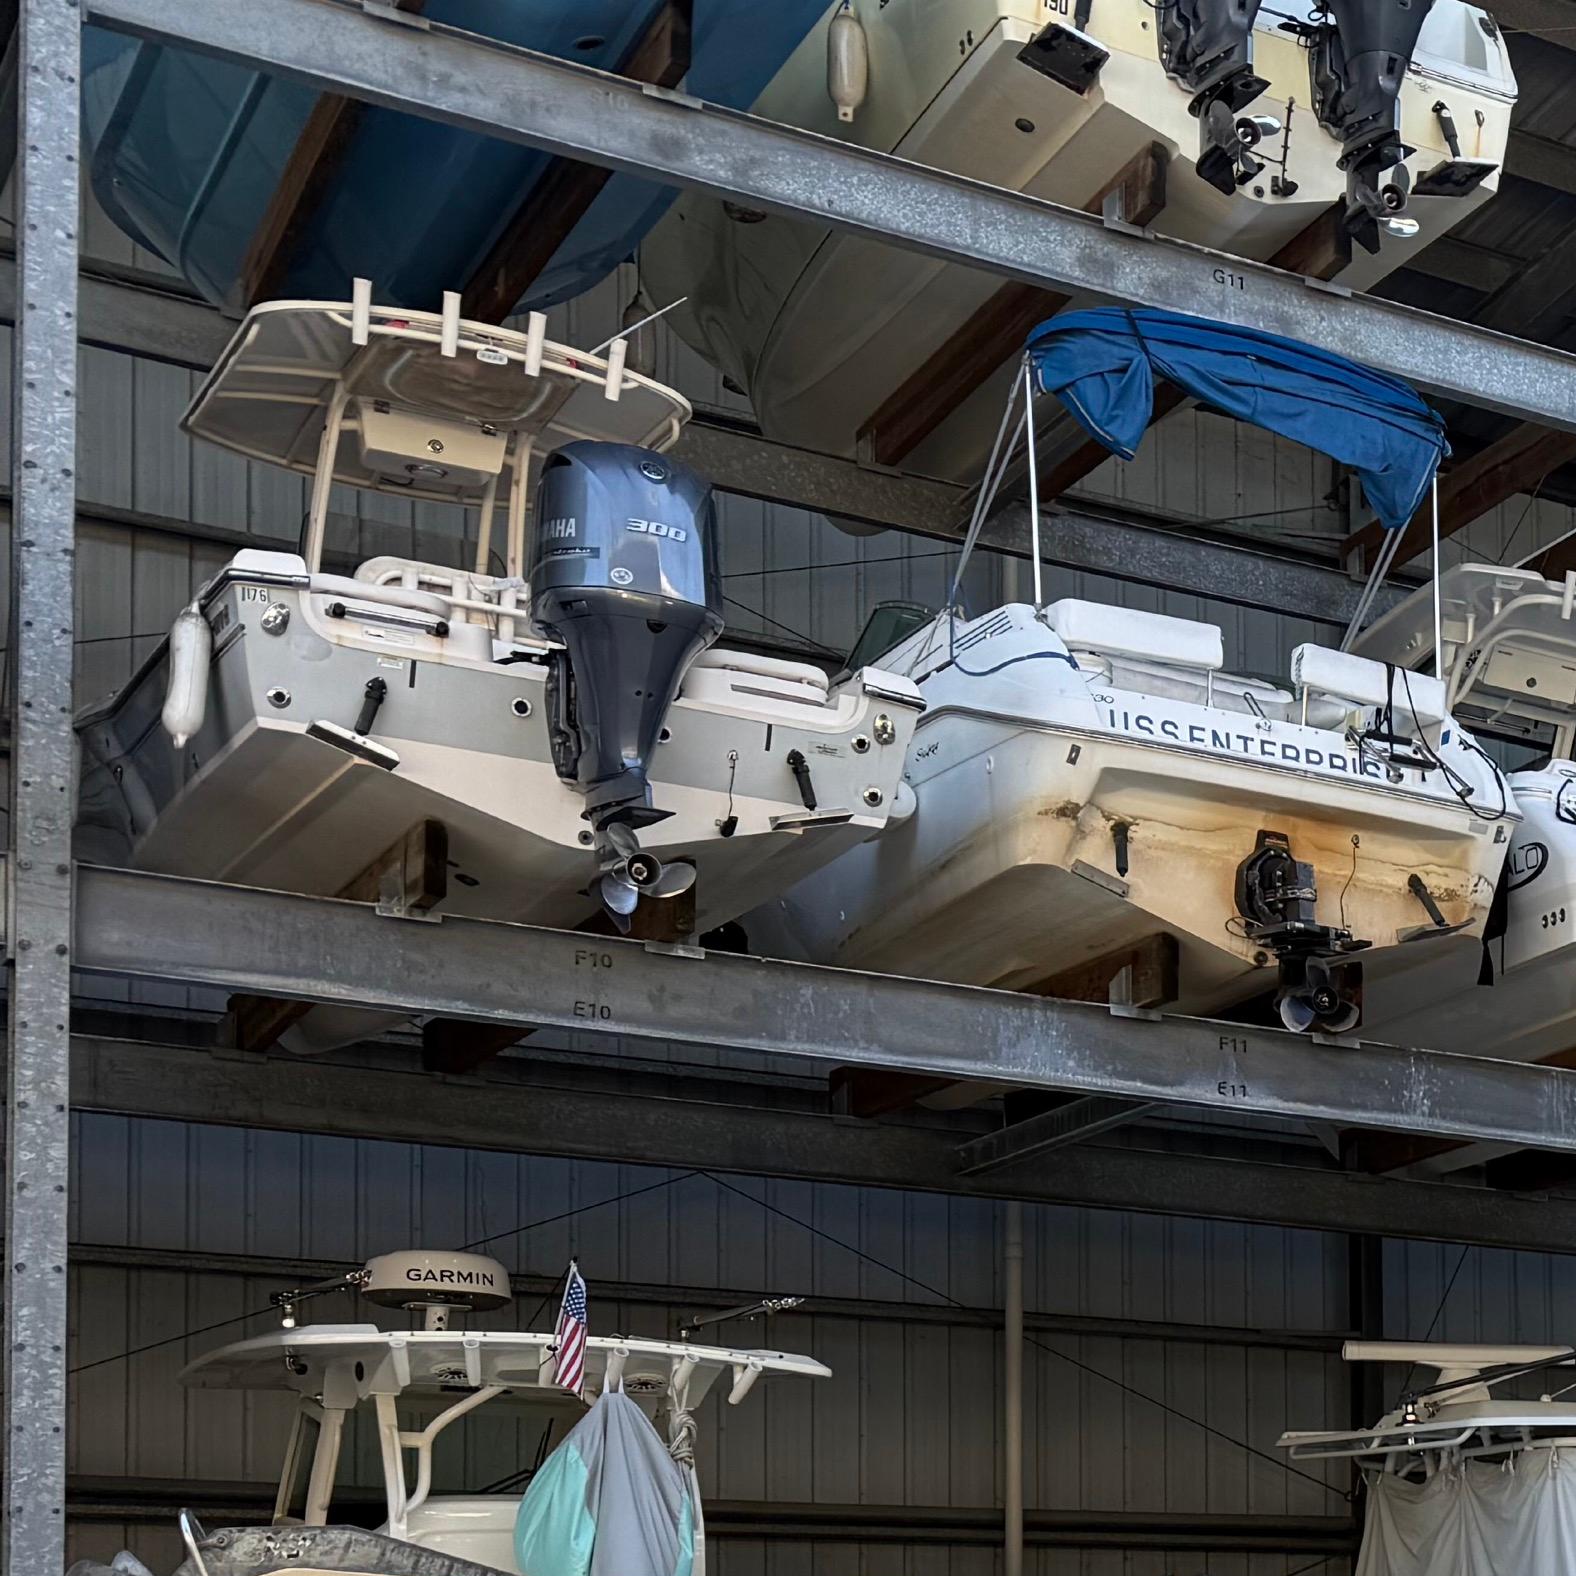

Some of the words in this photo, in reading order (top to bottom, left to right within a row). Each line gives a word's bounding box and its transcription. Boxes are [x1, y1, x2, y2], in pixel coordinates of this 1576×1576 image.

[1213, 269, 1244, 290] G11
[626, 517, 687, 543] 300
[575, 949, 612, 968] F10
[573, 1001, 611, 1020] E10
[1219, 1036, 1247, 1053] F11
[1217, 1081, 1246, 1097] E11
[406, 1268, 494, 1287] GARMIN
